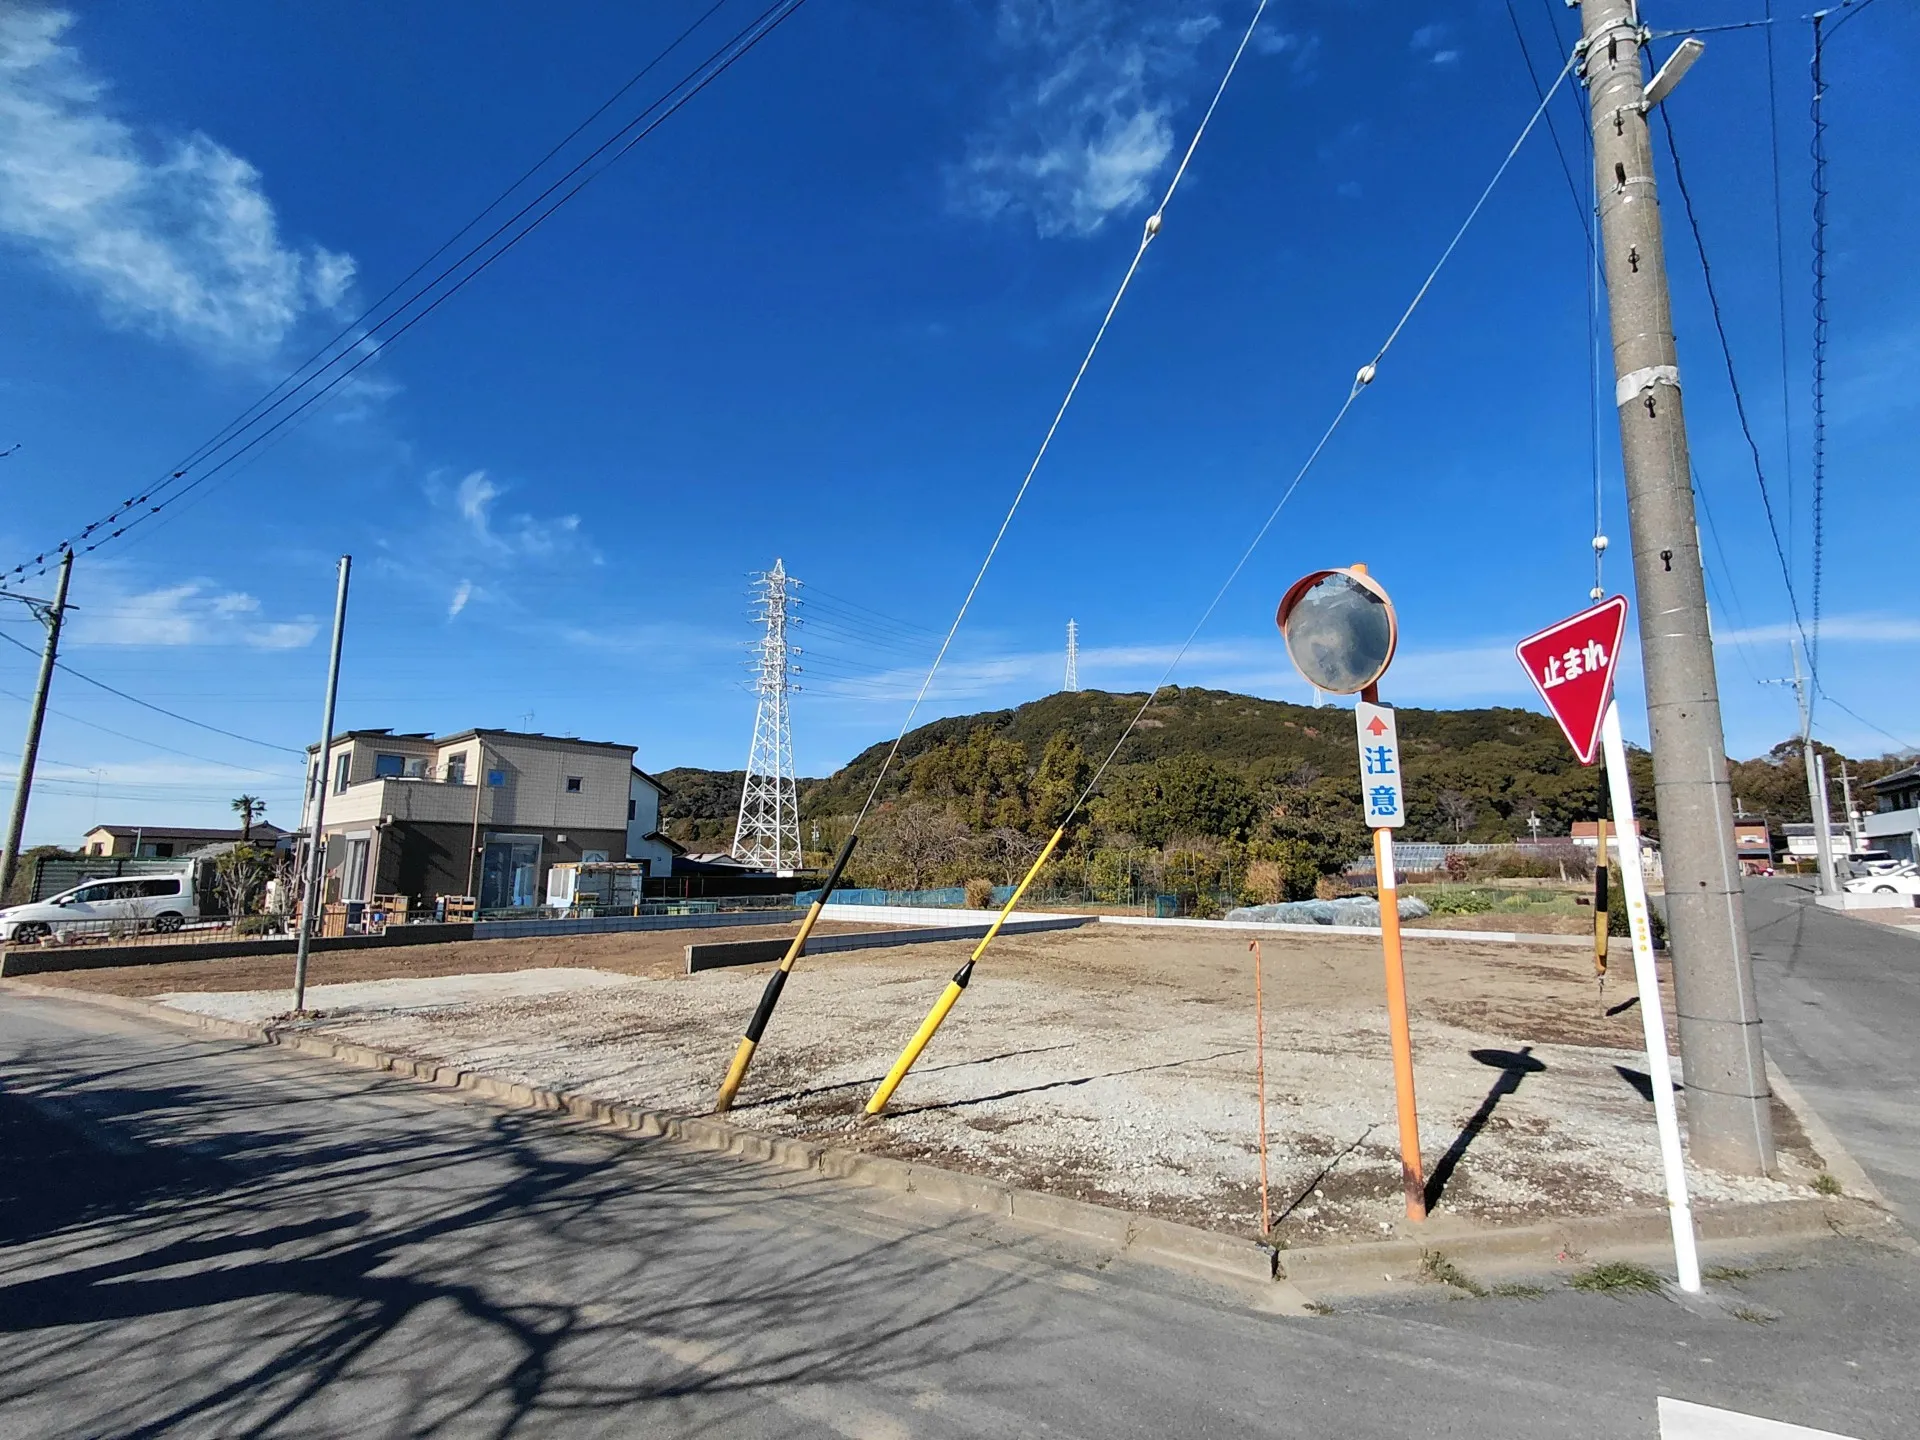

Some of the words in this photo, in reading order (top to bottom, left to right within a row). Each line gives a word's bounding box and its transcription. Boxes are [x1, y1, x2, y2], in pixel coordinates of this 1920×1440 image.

[1543, 639, 1608, 689] 止まれ
[1365, 745, 1398, 816] 注意
